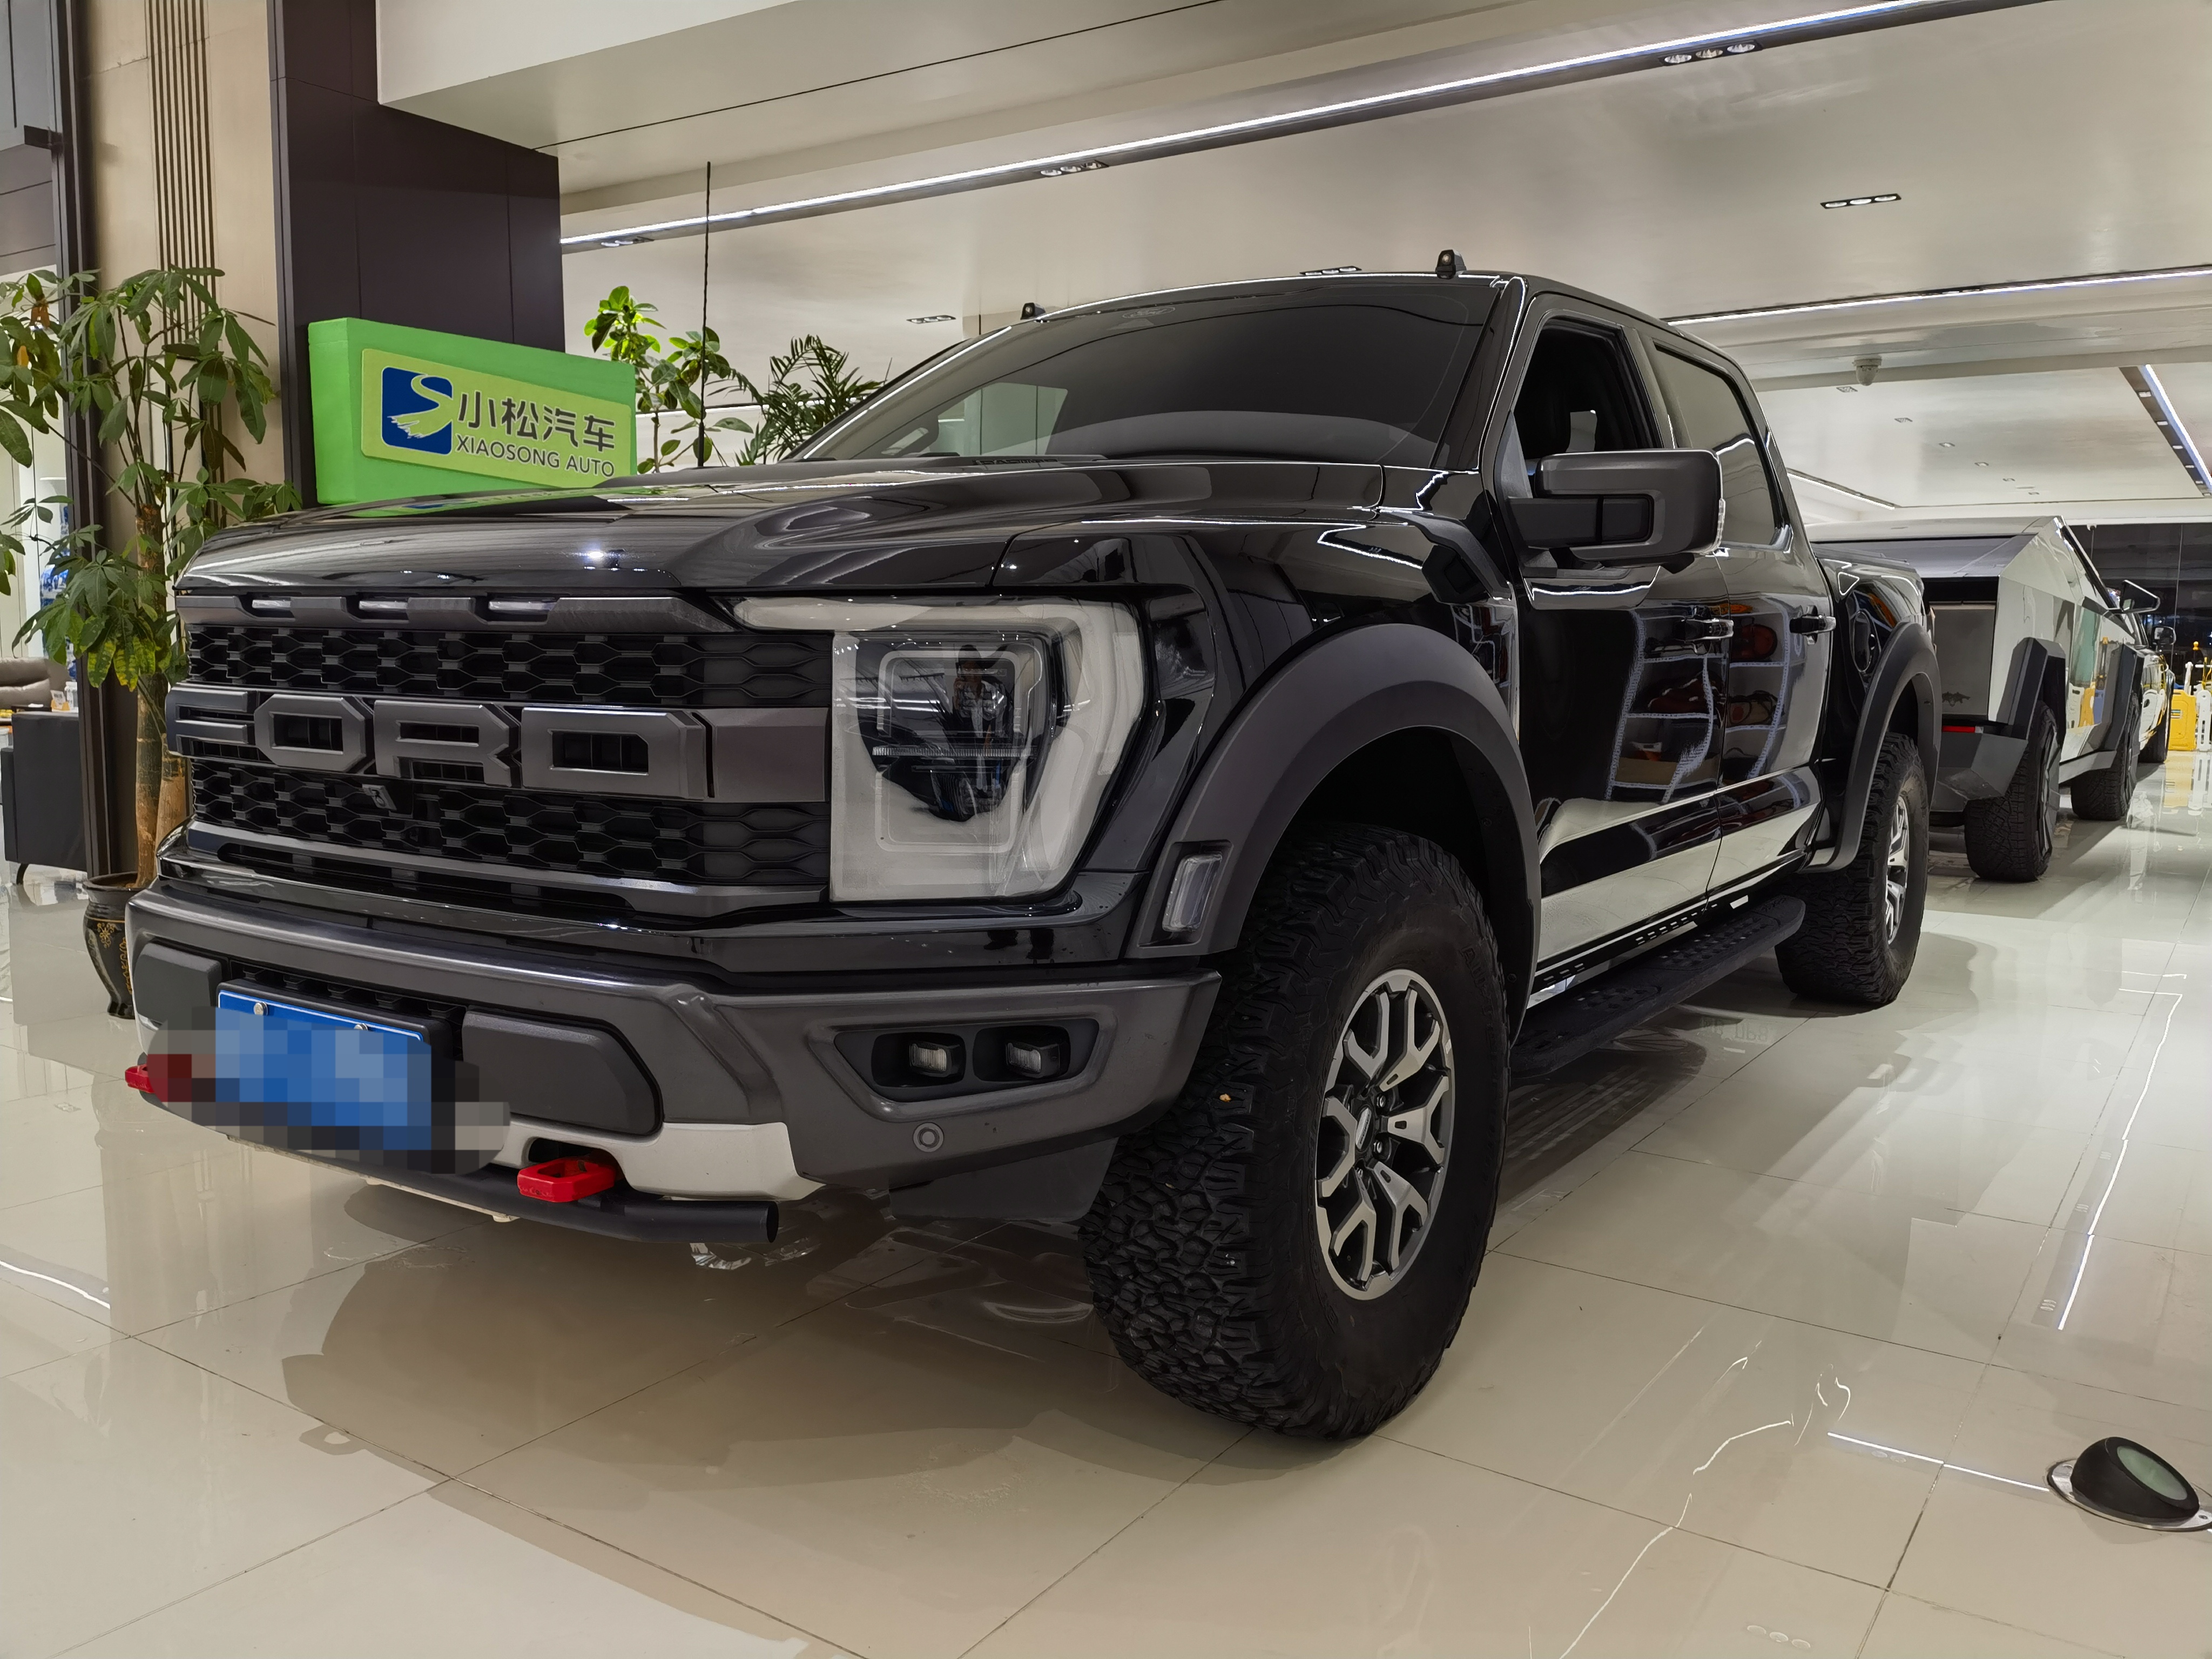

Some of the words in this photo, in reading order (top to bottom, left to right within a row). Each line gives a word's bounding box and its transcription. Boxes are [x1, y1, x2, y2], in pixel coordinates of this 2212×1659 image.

[458, 391, 615, 452] 小松汽车
[456, 434, 559, 468] XIAOSONG
[566, 455, 615, 477] AUTO
[165, 684, 706, 800] FORD
